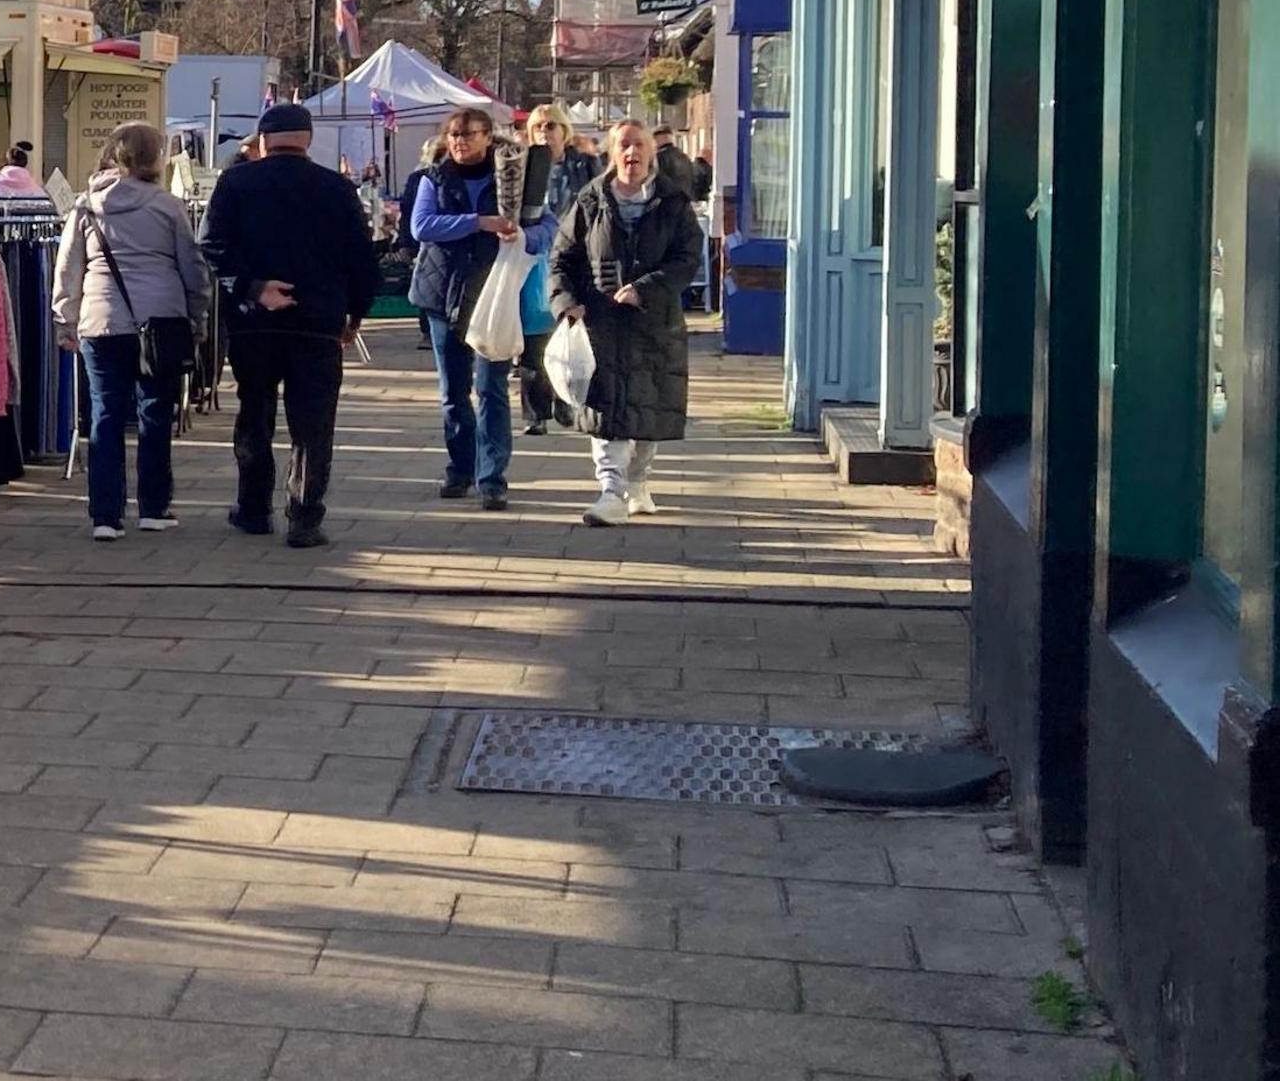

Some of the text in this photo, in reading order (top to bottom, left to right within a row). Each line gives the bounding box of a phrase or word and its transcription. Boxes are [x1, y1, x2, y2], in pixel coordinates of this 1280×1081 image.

[90, 83, 149, 93] HOT DOGS
[91, 100, 146, 109] QUARTER
[90, 111, 147, 120] POUNDER
